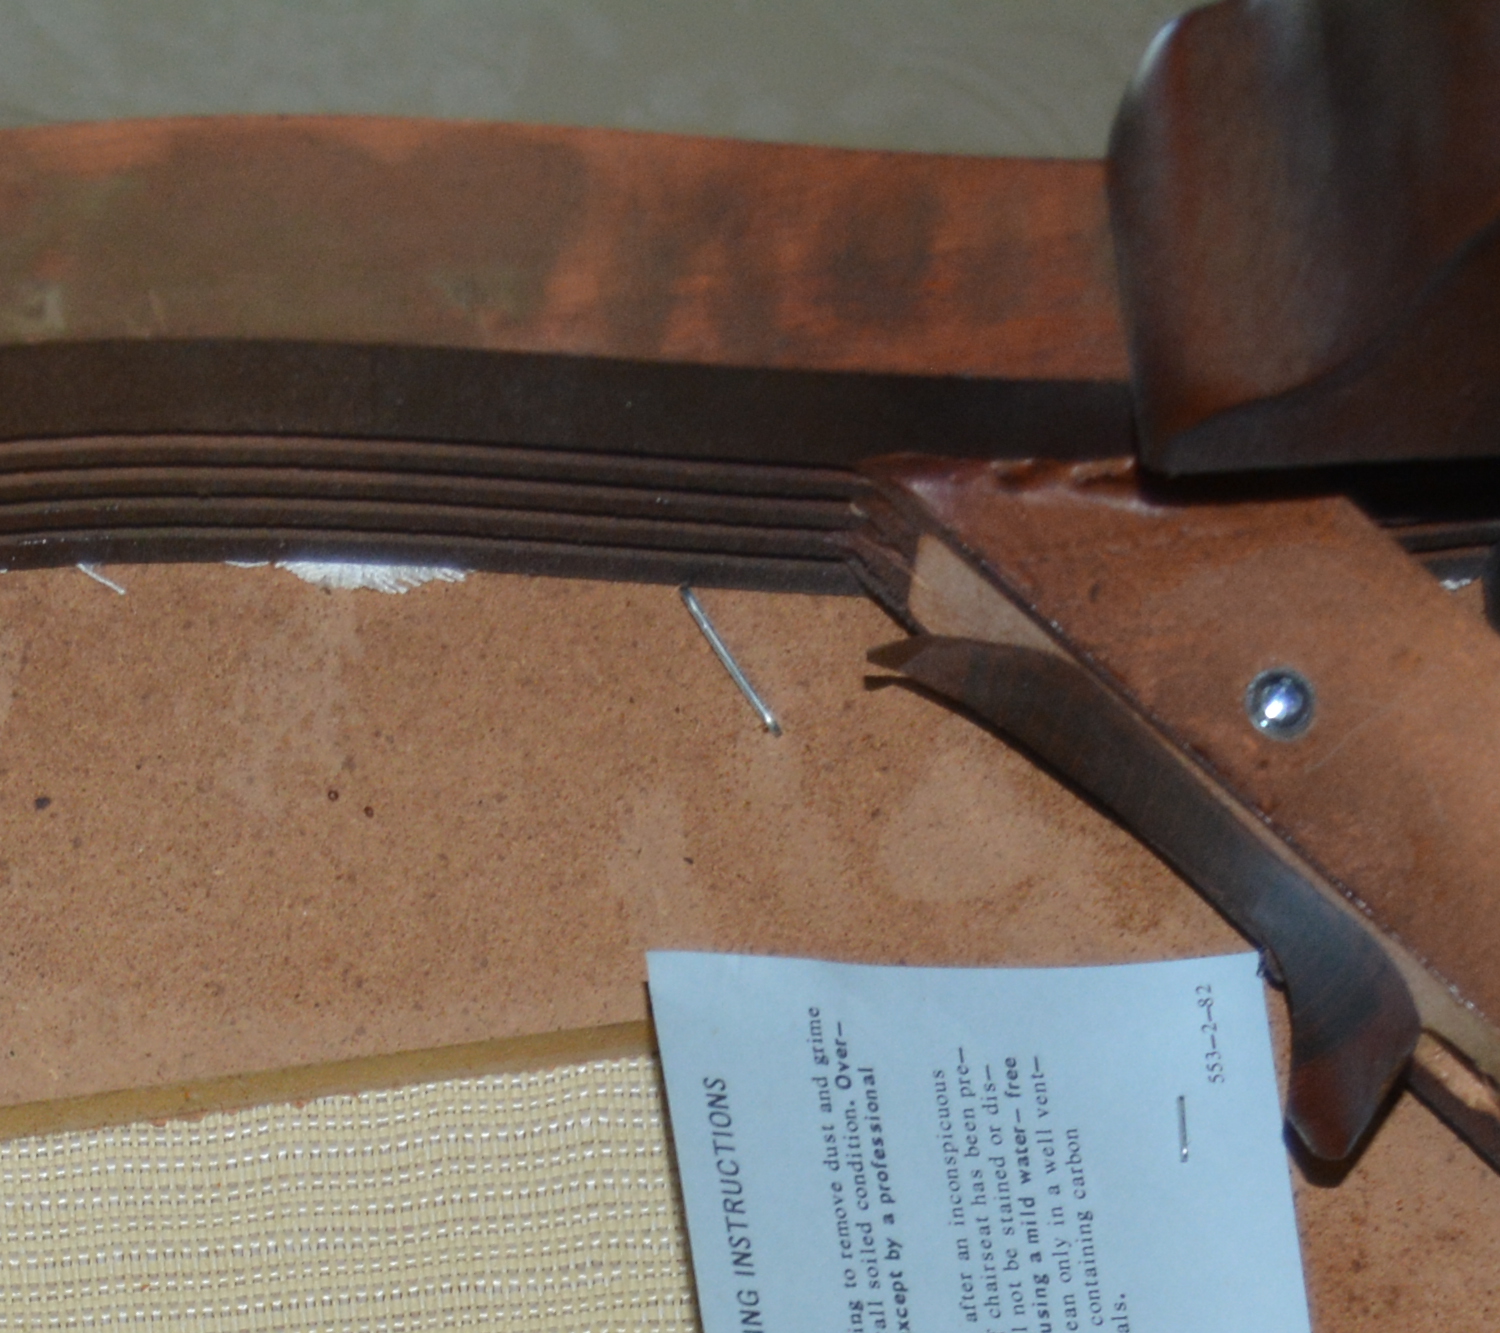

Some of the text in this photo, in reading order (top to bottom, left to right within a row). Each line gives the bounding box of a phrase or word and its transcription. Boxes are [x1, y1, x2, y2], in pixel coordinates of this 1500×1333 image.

[807, 1006, 830, 1066] grime
[833, 1020, 853, 1091] Over-
[810, 1075, 833, 1113] and
[820, 1123, 840, 1172] dust
[843, 1099, 870, 1211] condition.
[856, 1066, 896, 1204] professional
[701, 1076, 756, 1277] INSTRUCTIONS
[829, 1180, 853, 1259] remove
[881, 1212, 895, 1225] a
[883, 1236, 903, 1261] by
[842, 1267, 858, 1289] to
[854, 1221, 881, 1290] soiled
